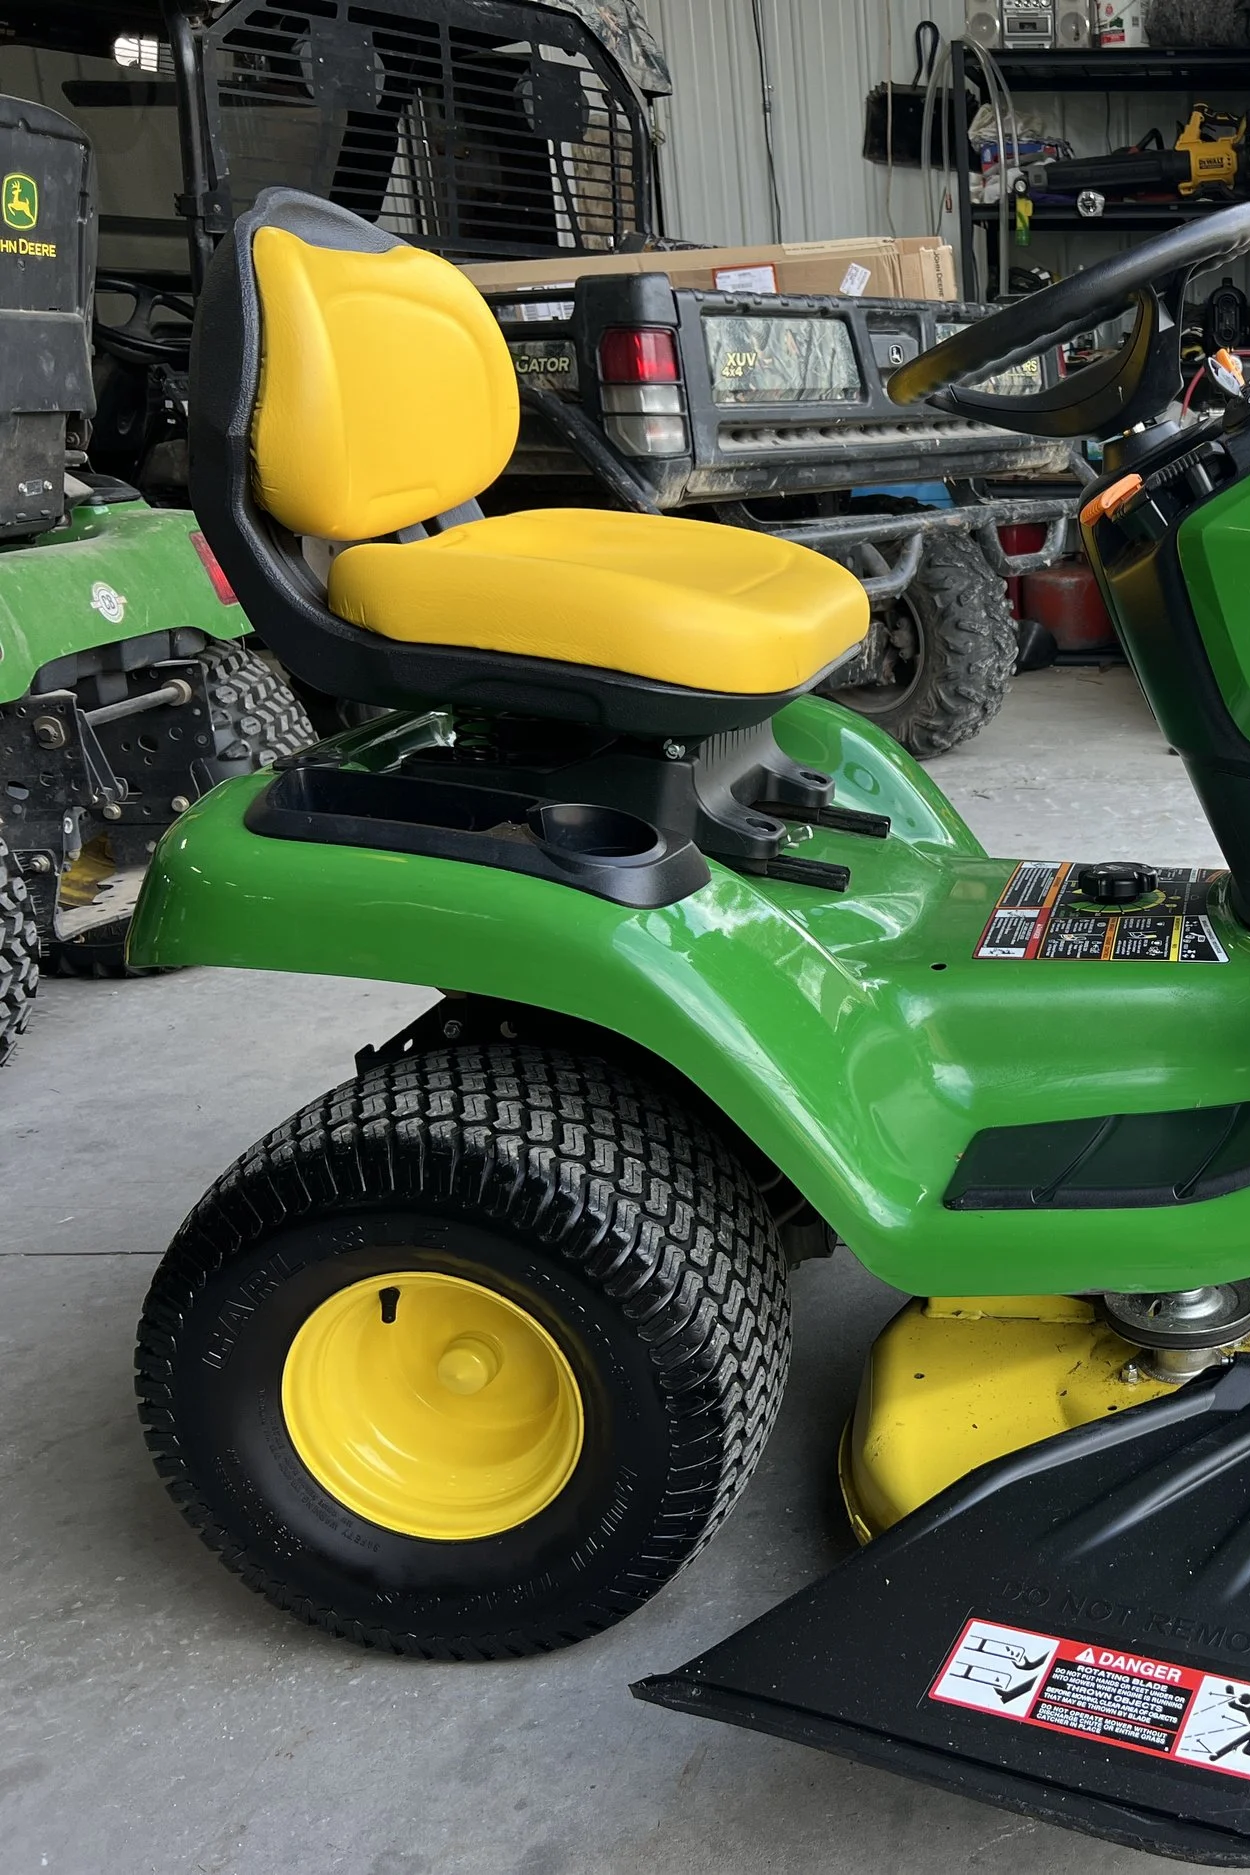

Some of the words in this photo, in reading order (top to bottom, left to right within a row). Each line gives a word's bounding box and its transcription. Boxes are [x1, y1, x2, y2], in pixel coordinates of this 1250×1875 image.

[19, 238, 57, 258] DEERE
[516, 355, 570, 373] GATOR
[726, 352, 757, 367] XUV
[1001, 1581, 1052, 1608] DO
[1060, 1589, 1138, 1628] NOT
[1076, 1664, 1130, 1683] ROTATING
[1131, 1678, 1168, 1692] BLADE
[1097, 1652, 1183, 1682] DANGER
[1051, 1672, 1069, 1681] INTO
[1068, 1676, 1095, 1688] MOWER
[1095, 1683, 1117, 1693] WHEN
[1116, 1688, 1143, 1699] ENGINE
[1150, 1696, 1184, 1709] RUNNING
[1064, 1683, 1112, 1700] THROWN
[1112, 1694, 1164, 1712] OBJECTS
[1065, 1669, 1081, 1678] NOT
[1080, 1673, 1095, 1681] PUT
[1095, 1676, 1119, 1687] HANDS
[1131, 1685, 1149, 1694] FEET
[1148, 1689, 1174, 1700] UNDER
[1173, 1695, 1186, 1703] OR
[1042, 1691, 1061, 1701] THAT
[1061, 1696, 1076, 1705] MAY
[1086, 1702, 1117, 1715] THROWN
[1127, 1712, 1151, 1723] BLADE
[1045, 1685, 1072, 1697] BEFORE
[1098, 1698, 1121, 1709] CLEAR
[1120, 1704, 1139, 1713] AREA
[1147, 1711, 1178, 1723] OBJECTS
[1035, 1712, 1069, 1726] CATCHER
[1077, 1722, 1101, 1733] PLACE
[1037, 1707, 1078, 1722] DISCHARGE
[1078, 1717, 1102, 1728] CHUTE
[1102, 1723, 1114, 1731] OR
[1114, 1726, 1140, 1738] ENTIRE
[1139, 1733, 1166, 1744] GRASS
[1040, 1702, 1052, 1710] DO
[1052, 1705, 1069, 1714] NOT
[1068, 1709, 1103, 1723] OPERATE
[1103, 1718, 1133, 1730] MOWER
[1132, 1725, 1167, 1739] WITHOUT
